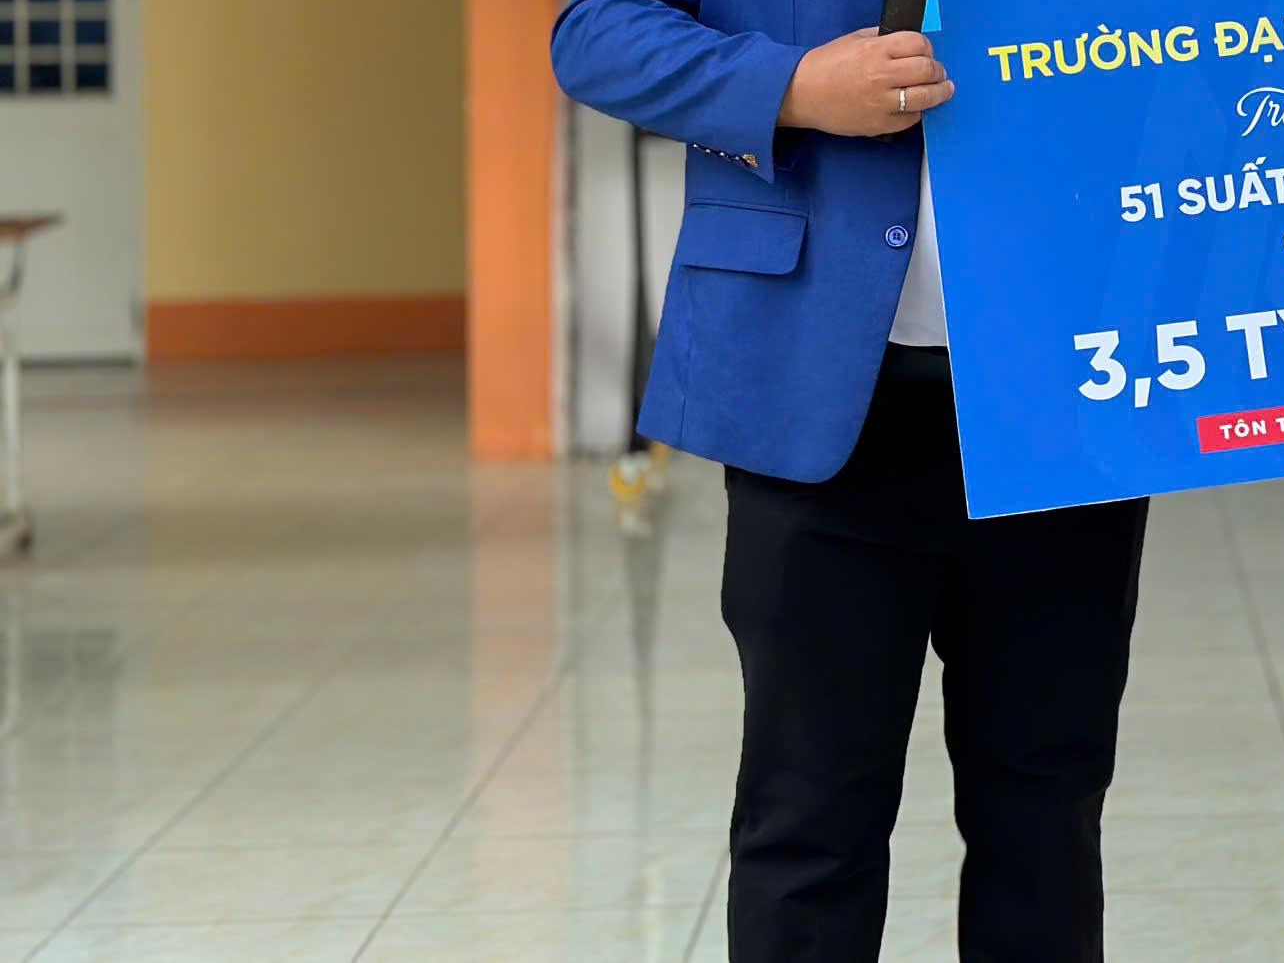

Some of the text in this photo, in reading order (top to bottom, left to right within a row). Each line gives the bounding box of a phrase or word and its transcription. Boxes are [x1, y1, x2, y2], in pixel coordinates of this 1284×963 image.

[987, 23, 1200, 82] TRƯỜNG
[1119, 182, 1165, 223] 51
[1073, 320, 1206, 408] 3,5
[1219, 418, 1267, 440] TÔN
